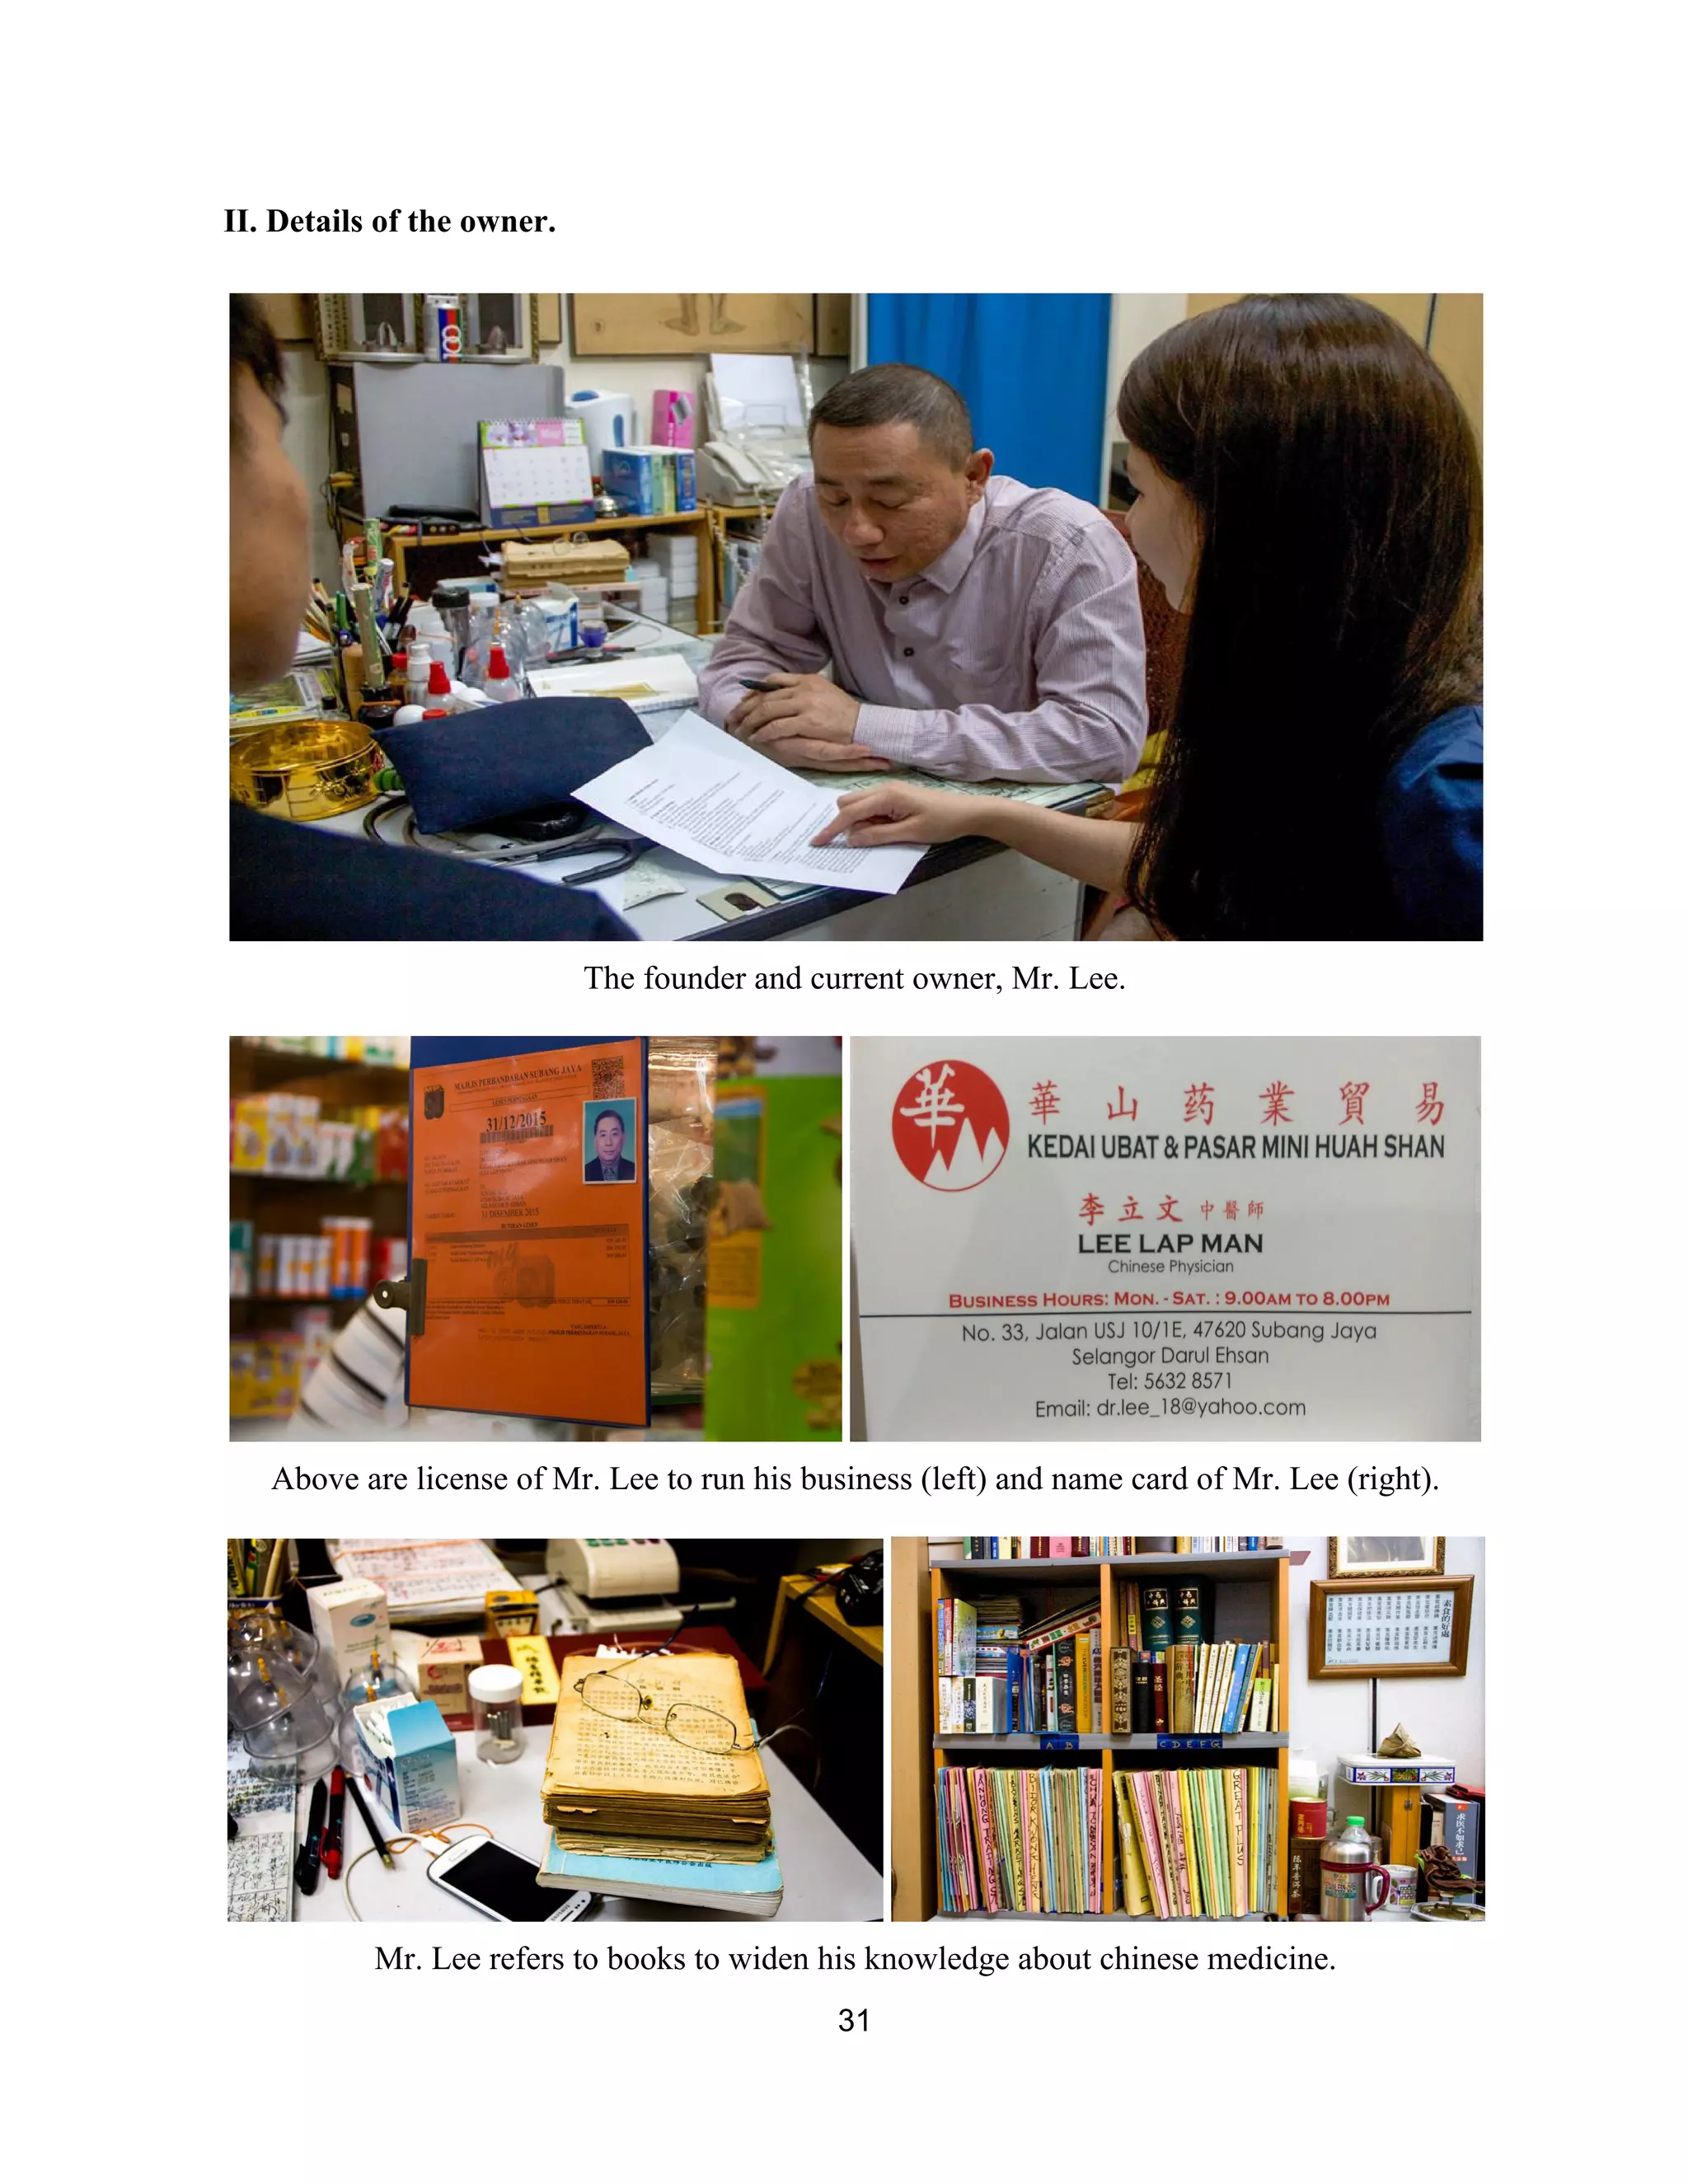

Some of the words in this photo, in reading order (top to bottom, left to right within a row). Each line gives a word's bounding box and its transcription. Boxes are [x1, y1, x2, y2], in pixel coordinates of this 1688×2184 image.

[224, 209, 256, 232] II.
[266, 209, 362, 232] Details
[373, 209, 401, 232] of
[408, 209, 451, 232] the
[461, 216, 555, 232] owner.
[584, 966, 634, 989] The
[645, 966, 746, 989] founder
[756, 966, 802, 989] and
[811, 969, 904, 989] current
[913, 973, 1001, 994] owner,
[1012, 967, 1058, 989] Mr.
[1070, 967, 1124, 989] Lee.
[1029, 1080, 1446, 1127] 華山药業貿易
[486, 1111, 546, 1132] 31/12/2015
[1029, 1135, 1094, 1158] KEDAI
[1102, 1136, 1159, 1158] UBAT
[1165, 1136, 1179, 1159] &
[1185, 1136, 1255, 1158] PASAR
[1263, 1136, 1308, 1158] MINI
[1316, 1135, 1377, 1158] HUAH
[1385, 1135, 1445, 1157] SHAN
[1079, 1193, 1183, 1225] 李立文
[1079, 1235, 1132, 1253] LEE
[1140, 1235, 1194, 1253] LAP
[1203, 1235, 1263, 1253] MAN
[1109, 1259, 1165, 1273] Chinese
[1170, 1259, 1234, 1276] Physician
[963, 1324, 996, 1342] No.
[1002, 1324, 1029, 1343] 33,
[1036, 1323, 1088, 1341] Jalan
[1095, 1322, 1125, 1339] USJ
[1133, 1321, 1187, 1342] 10/1E,
[1193, 1321, 1246, 1338] 47620
[1252, 1321, 1325, 1343] Subang
[1330, 1322, 1376, 1343] Jaya
[1072, 1348, 1156, 1369] Selangor
[1162, 1347, 1209, 1364] Darul
[1216, 1347, 1269, 1364] Ehsan
[1109, 1373, 1137, 1390] Tel:
[1144, 1372, 1186, 1390] 5632
[1192, 1372, 1231, 1389] 8571
[1036, 1399, 1090, 1417] Email:
[1097, 1398, 1306, 1419] dr.lee_18@yahoo.com
[271, 1466, 359, 1489] Above
[368, 1474, 407, 1489] are
[417, 1466, 507, 1490] license
[518, 1466, 547, 1489] of
[553, 1467, 598, 1489] Mr.
[610, 1467, 658, 1489] Lee
[668, 1469, 692, 1489] to
[701, 1474, 745, 1489] run
[754, 1466, 791, 1490] his
[800, 1466, 912, 1490] business
[922, 1466, 986, 1496] (left)
[996, 1466, 1043, 1489] and
[1052, 1474, 1122, 1489] name
[1132, 1466, 1188, 1489] card
[1198, 1466, 1227, 1489] of
[1233, 1467, 1278, 1489] Mr.
[1290, 1467, 1338, 1489] Lee
[1348, 1466, 1437, 1497] (right).
[1232, 1770, 1241, 1822] GREAT
[1236, 1825, 1244, 1866] PLUS
[1456, 1813, 1466, 1856] 求医不如求己
[375, 1947, 421, 1970] Mr.
[433, 1947, 480, 1970] Lee
[490, 1946, 564, 1970] refers
[574, 1950, 598, 1970] to
[607, 1946, 685, 1970] books
[695, 1949, 719, 1970] to
[729, 1946, 809, 1970] widen
[818, 1946, 855, 1970] his
[865, 1946, 1009, 1976] knowledge
[1019, 1946, 1091, 1970] about
[1100, 1946, 1198, 1970] chinese
[1208, 1946, 1334, 1970] medicine.
[839, 2008, 867, 2032] 31
